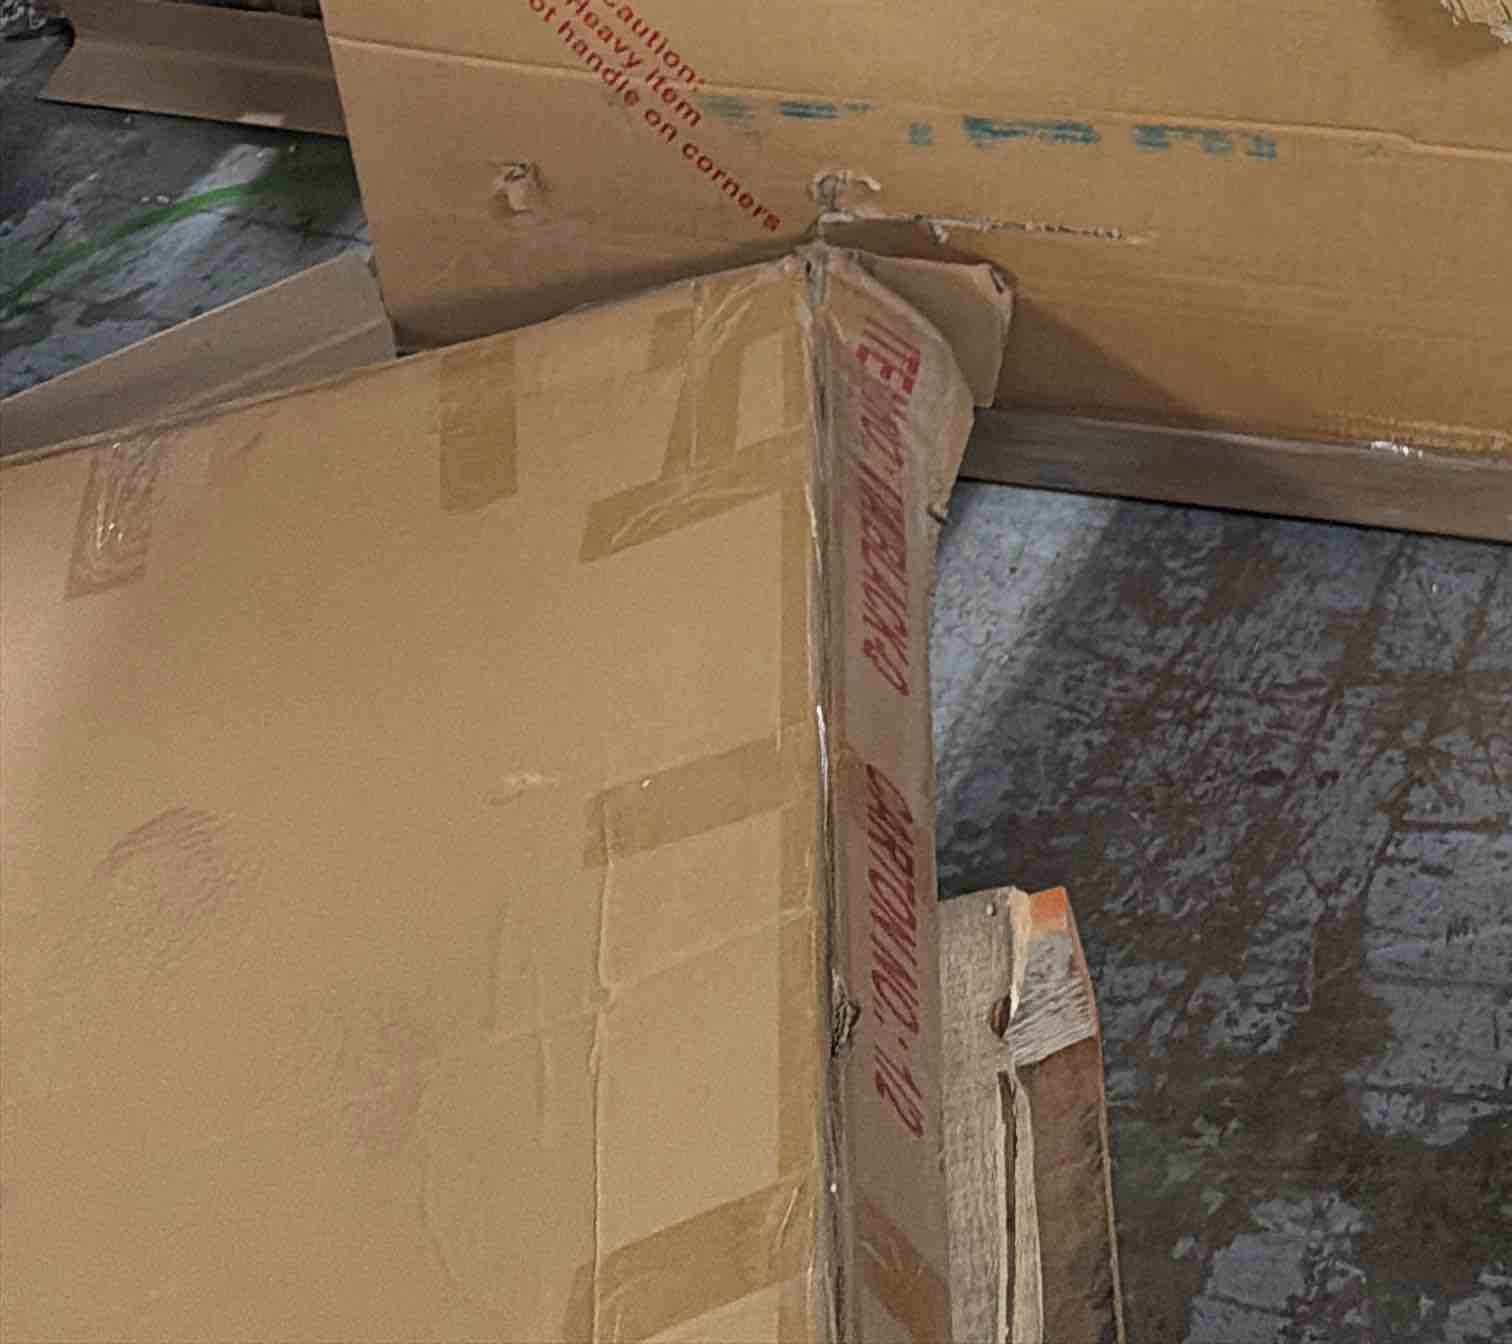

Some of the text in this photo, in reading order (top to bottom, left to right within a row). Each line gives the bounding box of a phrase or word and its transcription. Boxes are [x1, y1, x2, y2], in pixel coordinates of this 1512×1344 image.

[557, 20, 641, 107] handle
[644, 109, 679, 144] on
[681, 143, 782, 232] corners
[646, 68, 702, 128] item
[867, 764, 918, 967] CARTON
